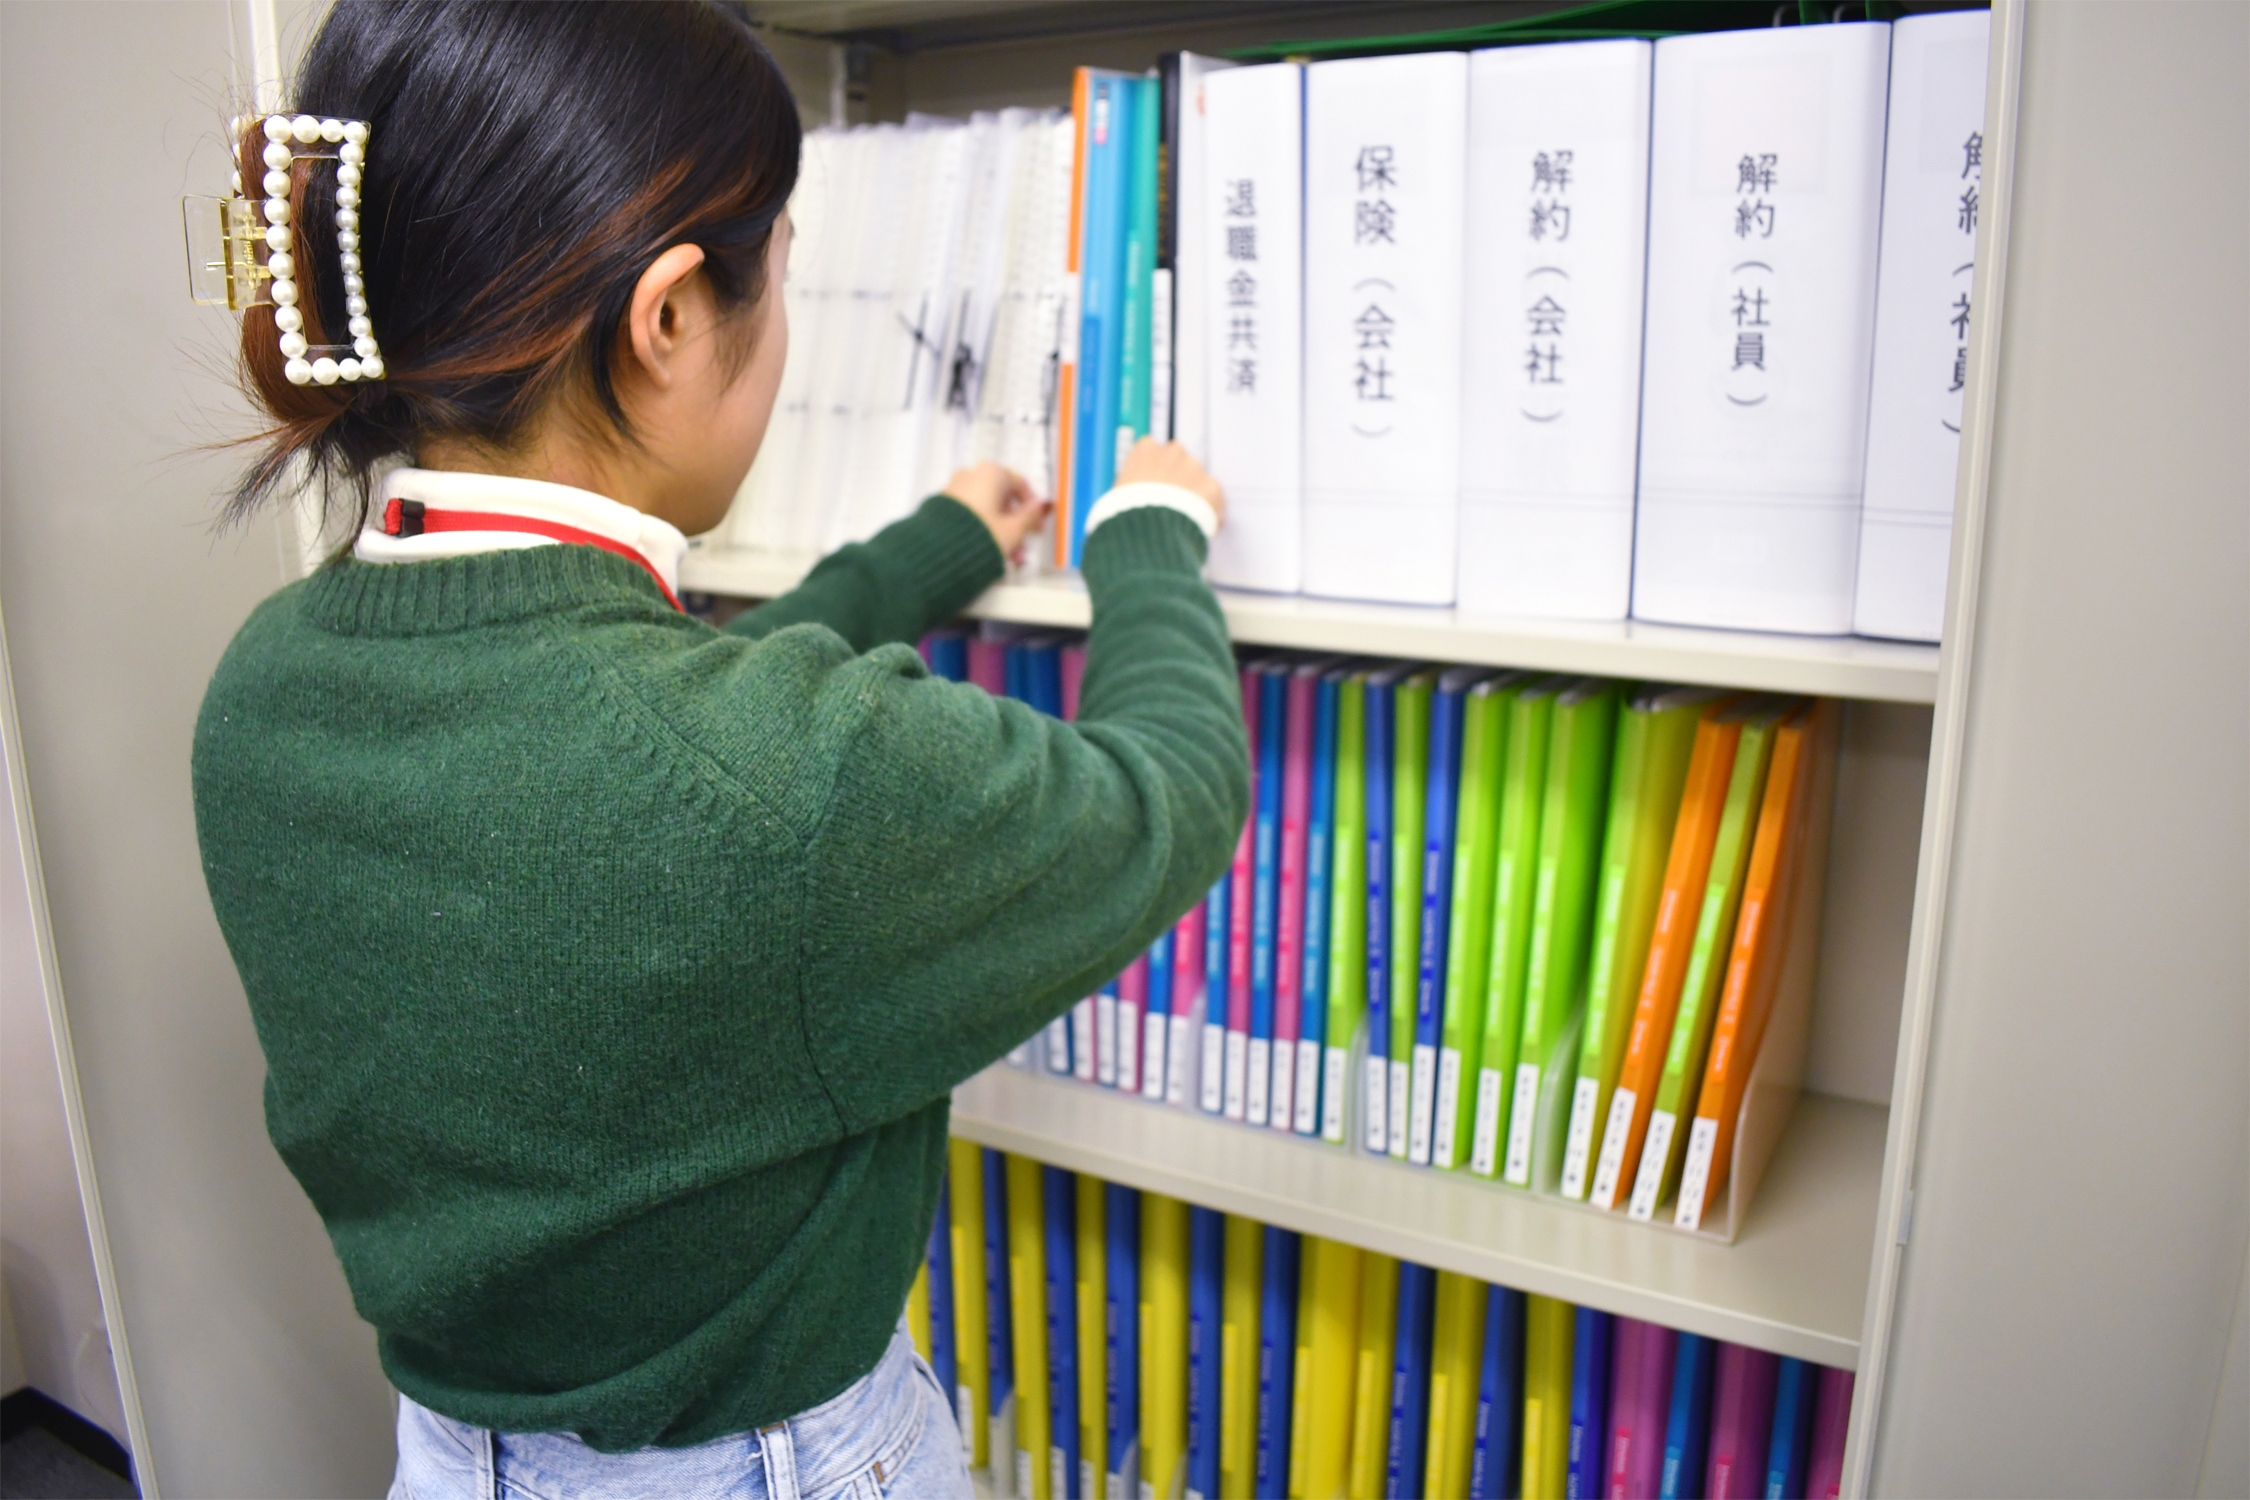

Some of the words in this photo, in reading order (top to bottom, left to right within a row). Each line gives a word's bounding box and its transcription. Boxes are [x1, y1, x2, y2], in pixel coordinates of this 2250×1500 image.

[1352, 145, 1397, 438] 保険（会社）
[1521, 149, 1573, 423] 解約（会社）
[1725, 153, 1778, 407] 解約（社員）
